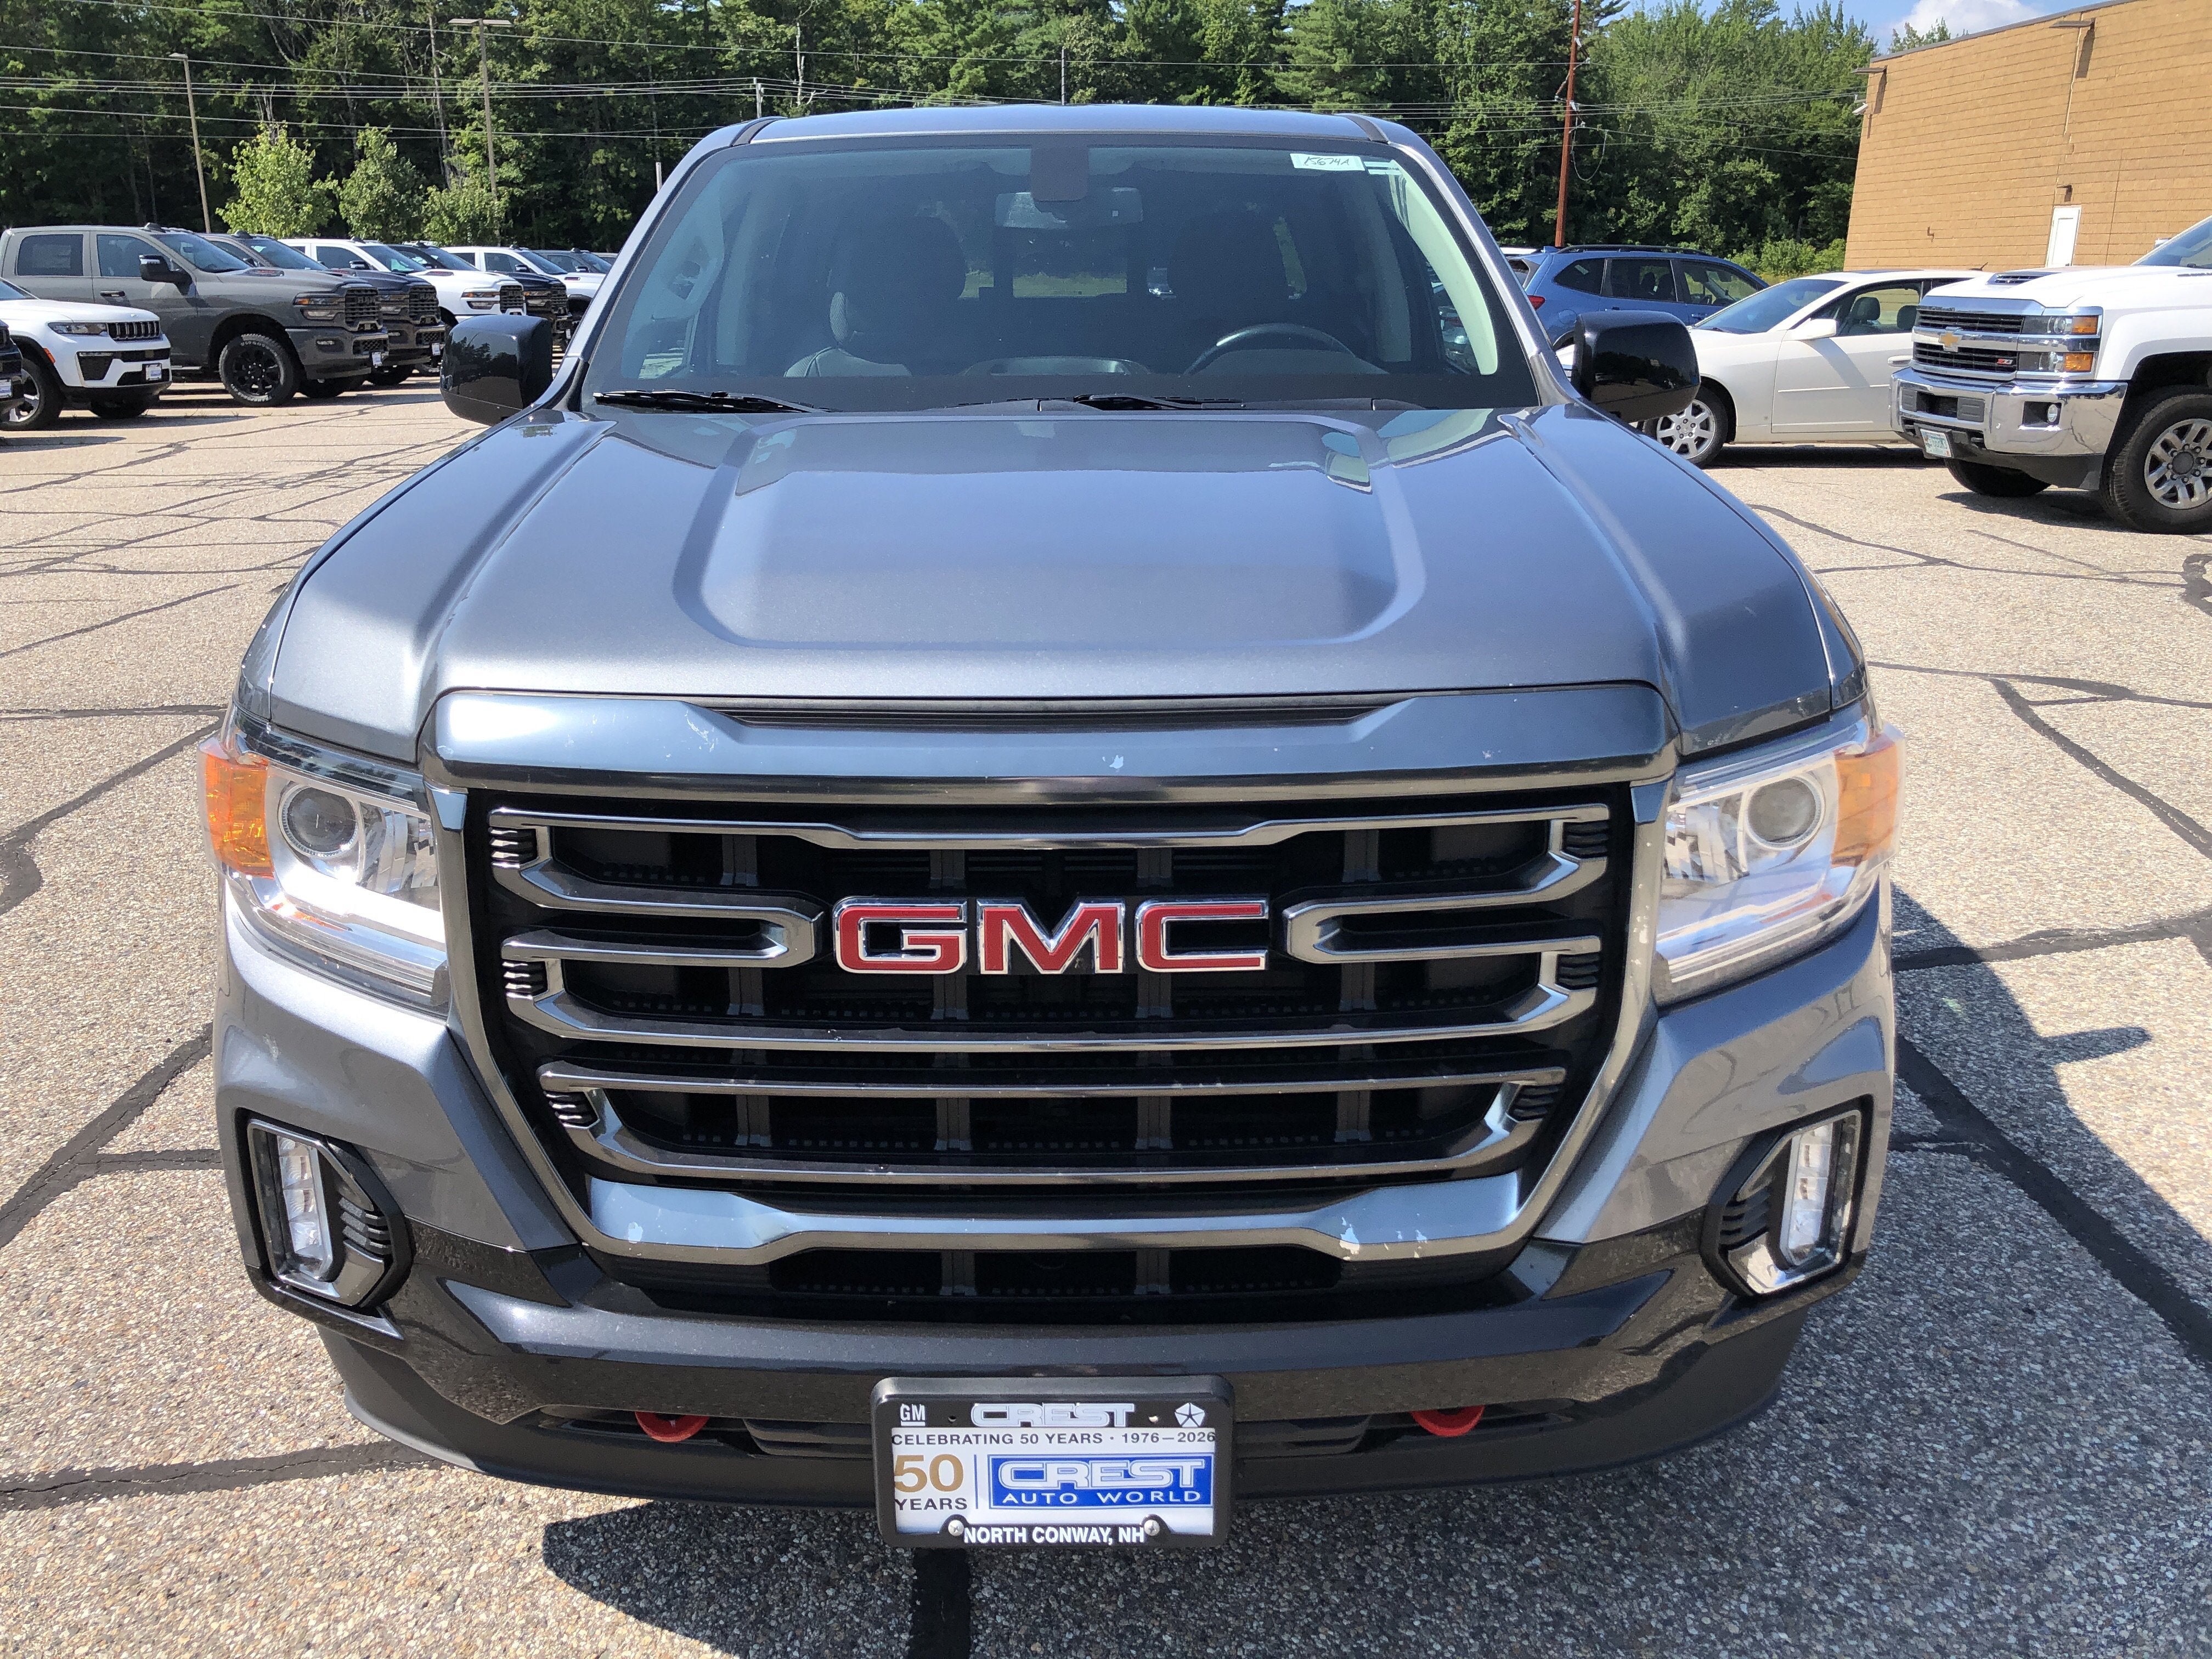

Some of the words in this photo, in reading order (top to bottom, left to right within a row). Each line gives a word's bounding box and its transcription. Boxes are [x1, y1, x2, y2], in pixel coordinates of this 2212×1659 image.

[833, 895, 1268, 974] GMC
[900, 1403, 926, 1421] GM
[970, 1403, 1135, 1427] CREST
[892, 1434, 1014, 1446] CELEBRATING
[1019, 1433, 1039, 1444] 50
[1045, 1432, 1103, 1444] YEARS
[894, 1454, 964, 1493] 50
[998, 1459, 1205, 1490] CREST
[894, 1497, 968, 1511] YEARS
[1002, 1492, 1078, 1505] AUTO
[1097, 1491, 1201, 1504] WORLD
[964, 1526, 1027, 1544] NORTH
[1031, 1526, 1114, 1545] CONWAY,
[1118, 1526, 1145, 1543] NH
